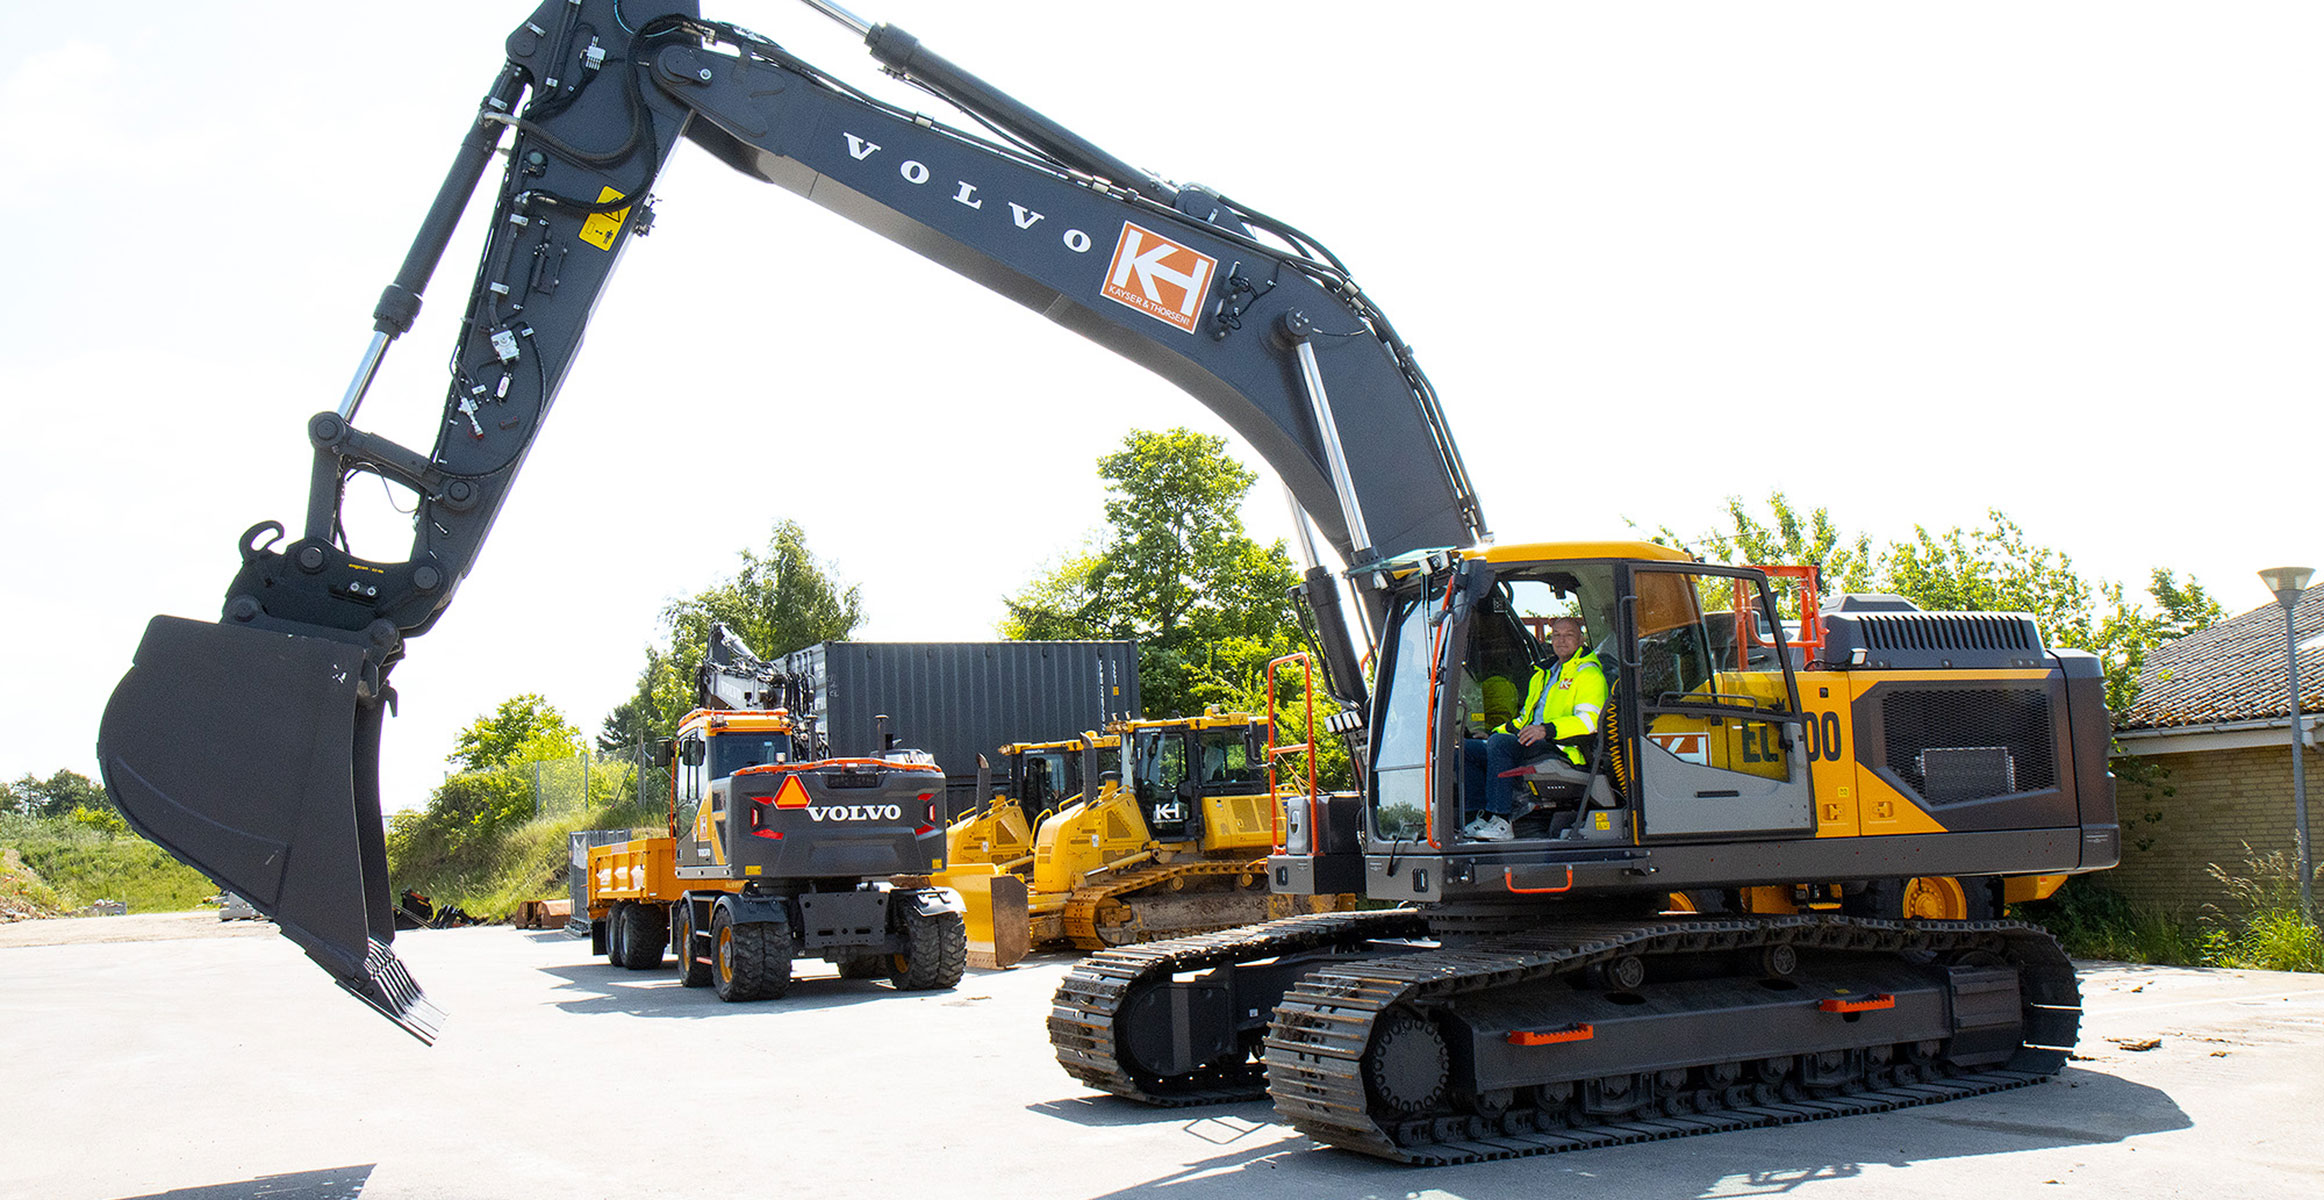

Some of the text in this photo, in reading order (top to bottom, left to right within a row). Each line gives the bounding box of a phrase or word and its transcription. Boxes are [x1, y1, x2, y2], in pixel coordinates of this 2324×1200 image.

[843, 131, 1092, 253] VOLVO
[1112, 228, 1210, 317] KH
[1108, 284, 1144, 305] KAYSER
[807, 804, 902, 822] VOLVO
[1155, 803, 1181, 820] KH
